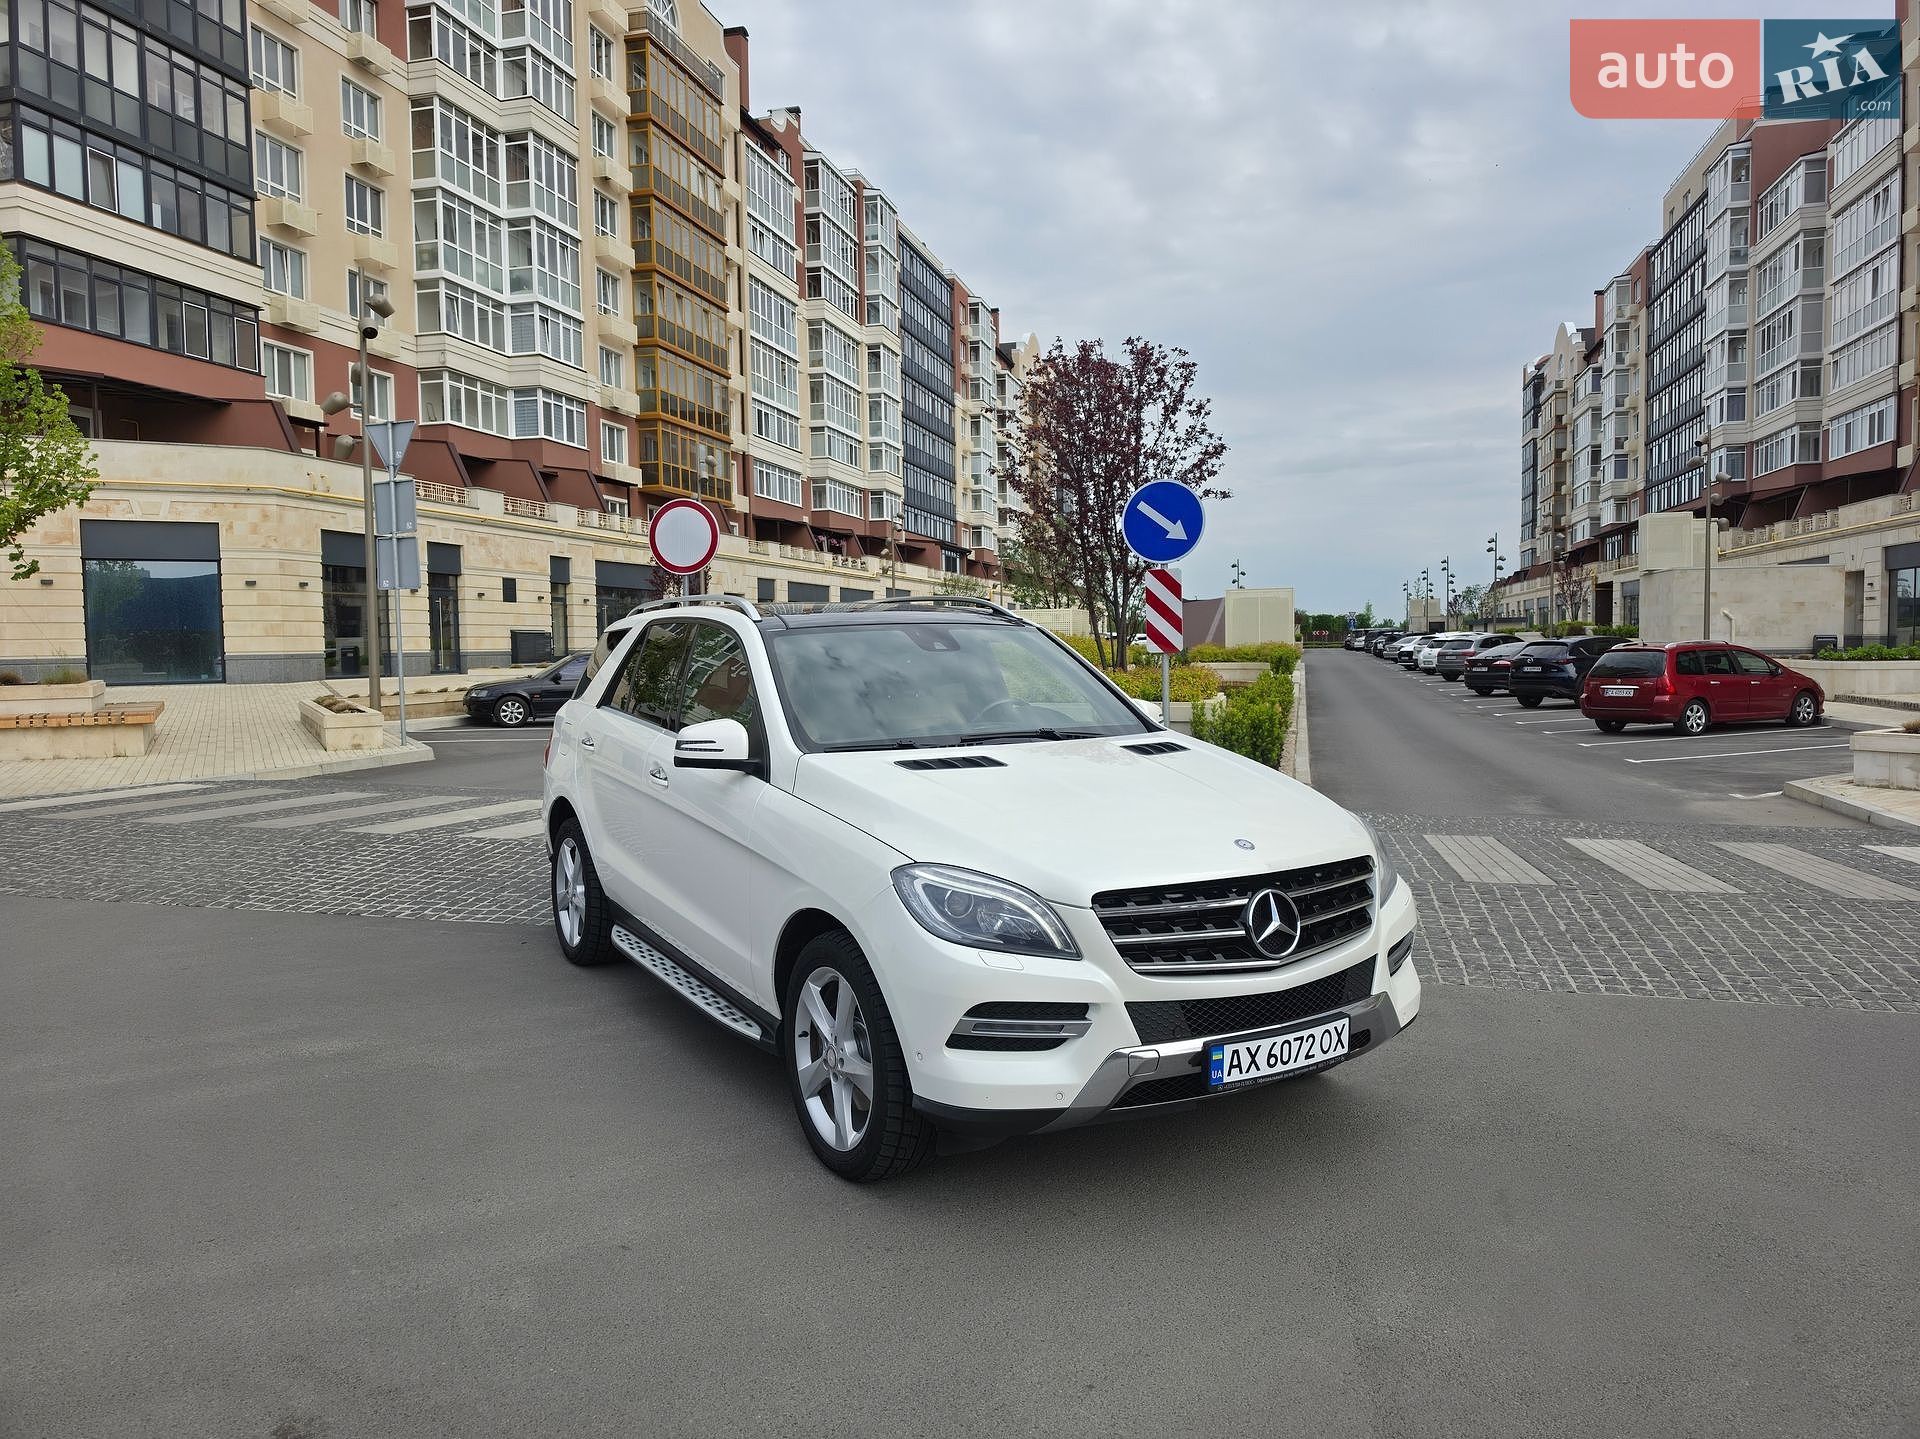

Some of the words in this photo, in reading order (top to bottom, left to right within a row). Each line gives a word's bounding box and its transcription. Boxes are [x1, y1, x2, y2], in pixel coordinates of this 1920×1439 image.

[1227, 1045, 1262, 1077] AX
[1266, 1033, 1316, 1069] 6072
[1320, 1023, 1346, 1055] OX
[1211, 1070, 1223, 1079] UA
